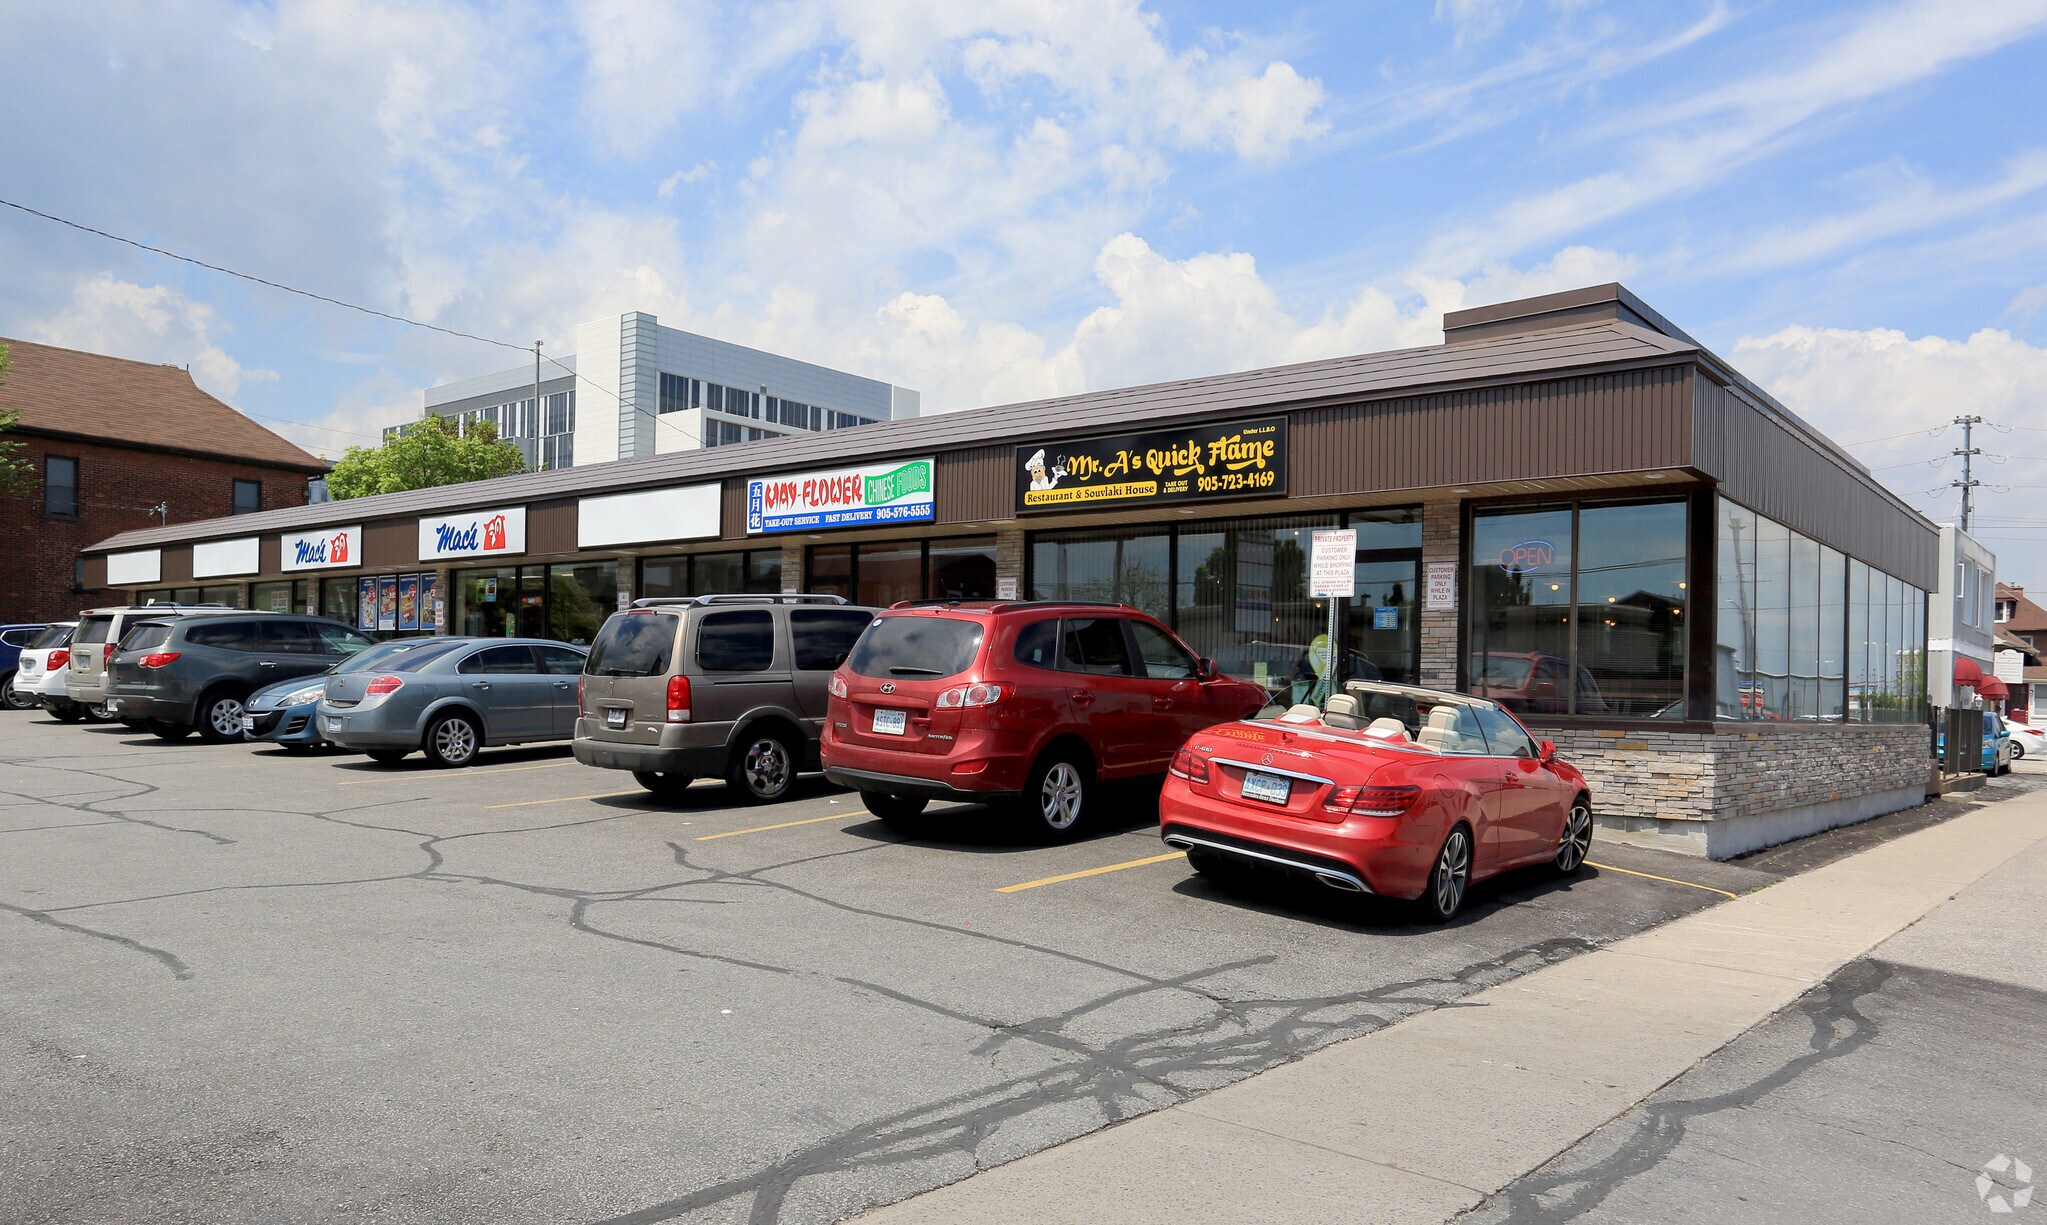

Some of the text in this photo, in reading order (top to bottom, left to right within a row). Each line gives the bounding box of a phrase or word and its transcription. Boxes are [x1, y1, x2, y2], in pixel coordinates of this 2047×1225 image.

[1067, 434, 1274, 480] Mr. A's Quick Flame
[765, 474, 862, 513] MAY-FLOWER
[868, 465, 926, 504] CHINESE FOODS
[1028, 486, 1154, 503] Restaurant & Souvlaki House
[1198, 471, 1274, 492] 905-723-4169
[751, 484, 761, 528] 五月花
[765, 504, 930, 528] TAKE-OUT SERVICE FAST DELIVERY 905-576-5555
[436, 522, 478, 552] Mac's
[295, 538, 326, 565] Mac's
[1500, 548, 1552, 566] OPEN
